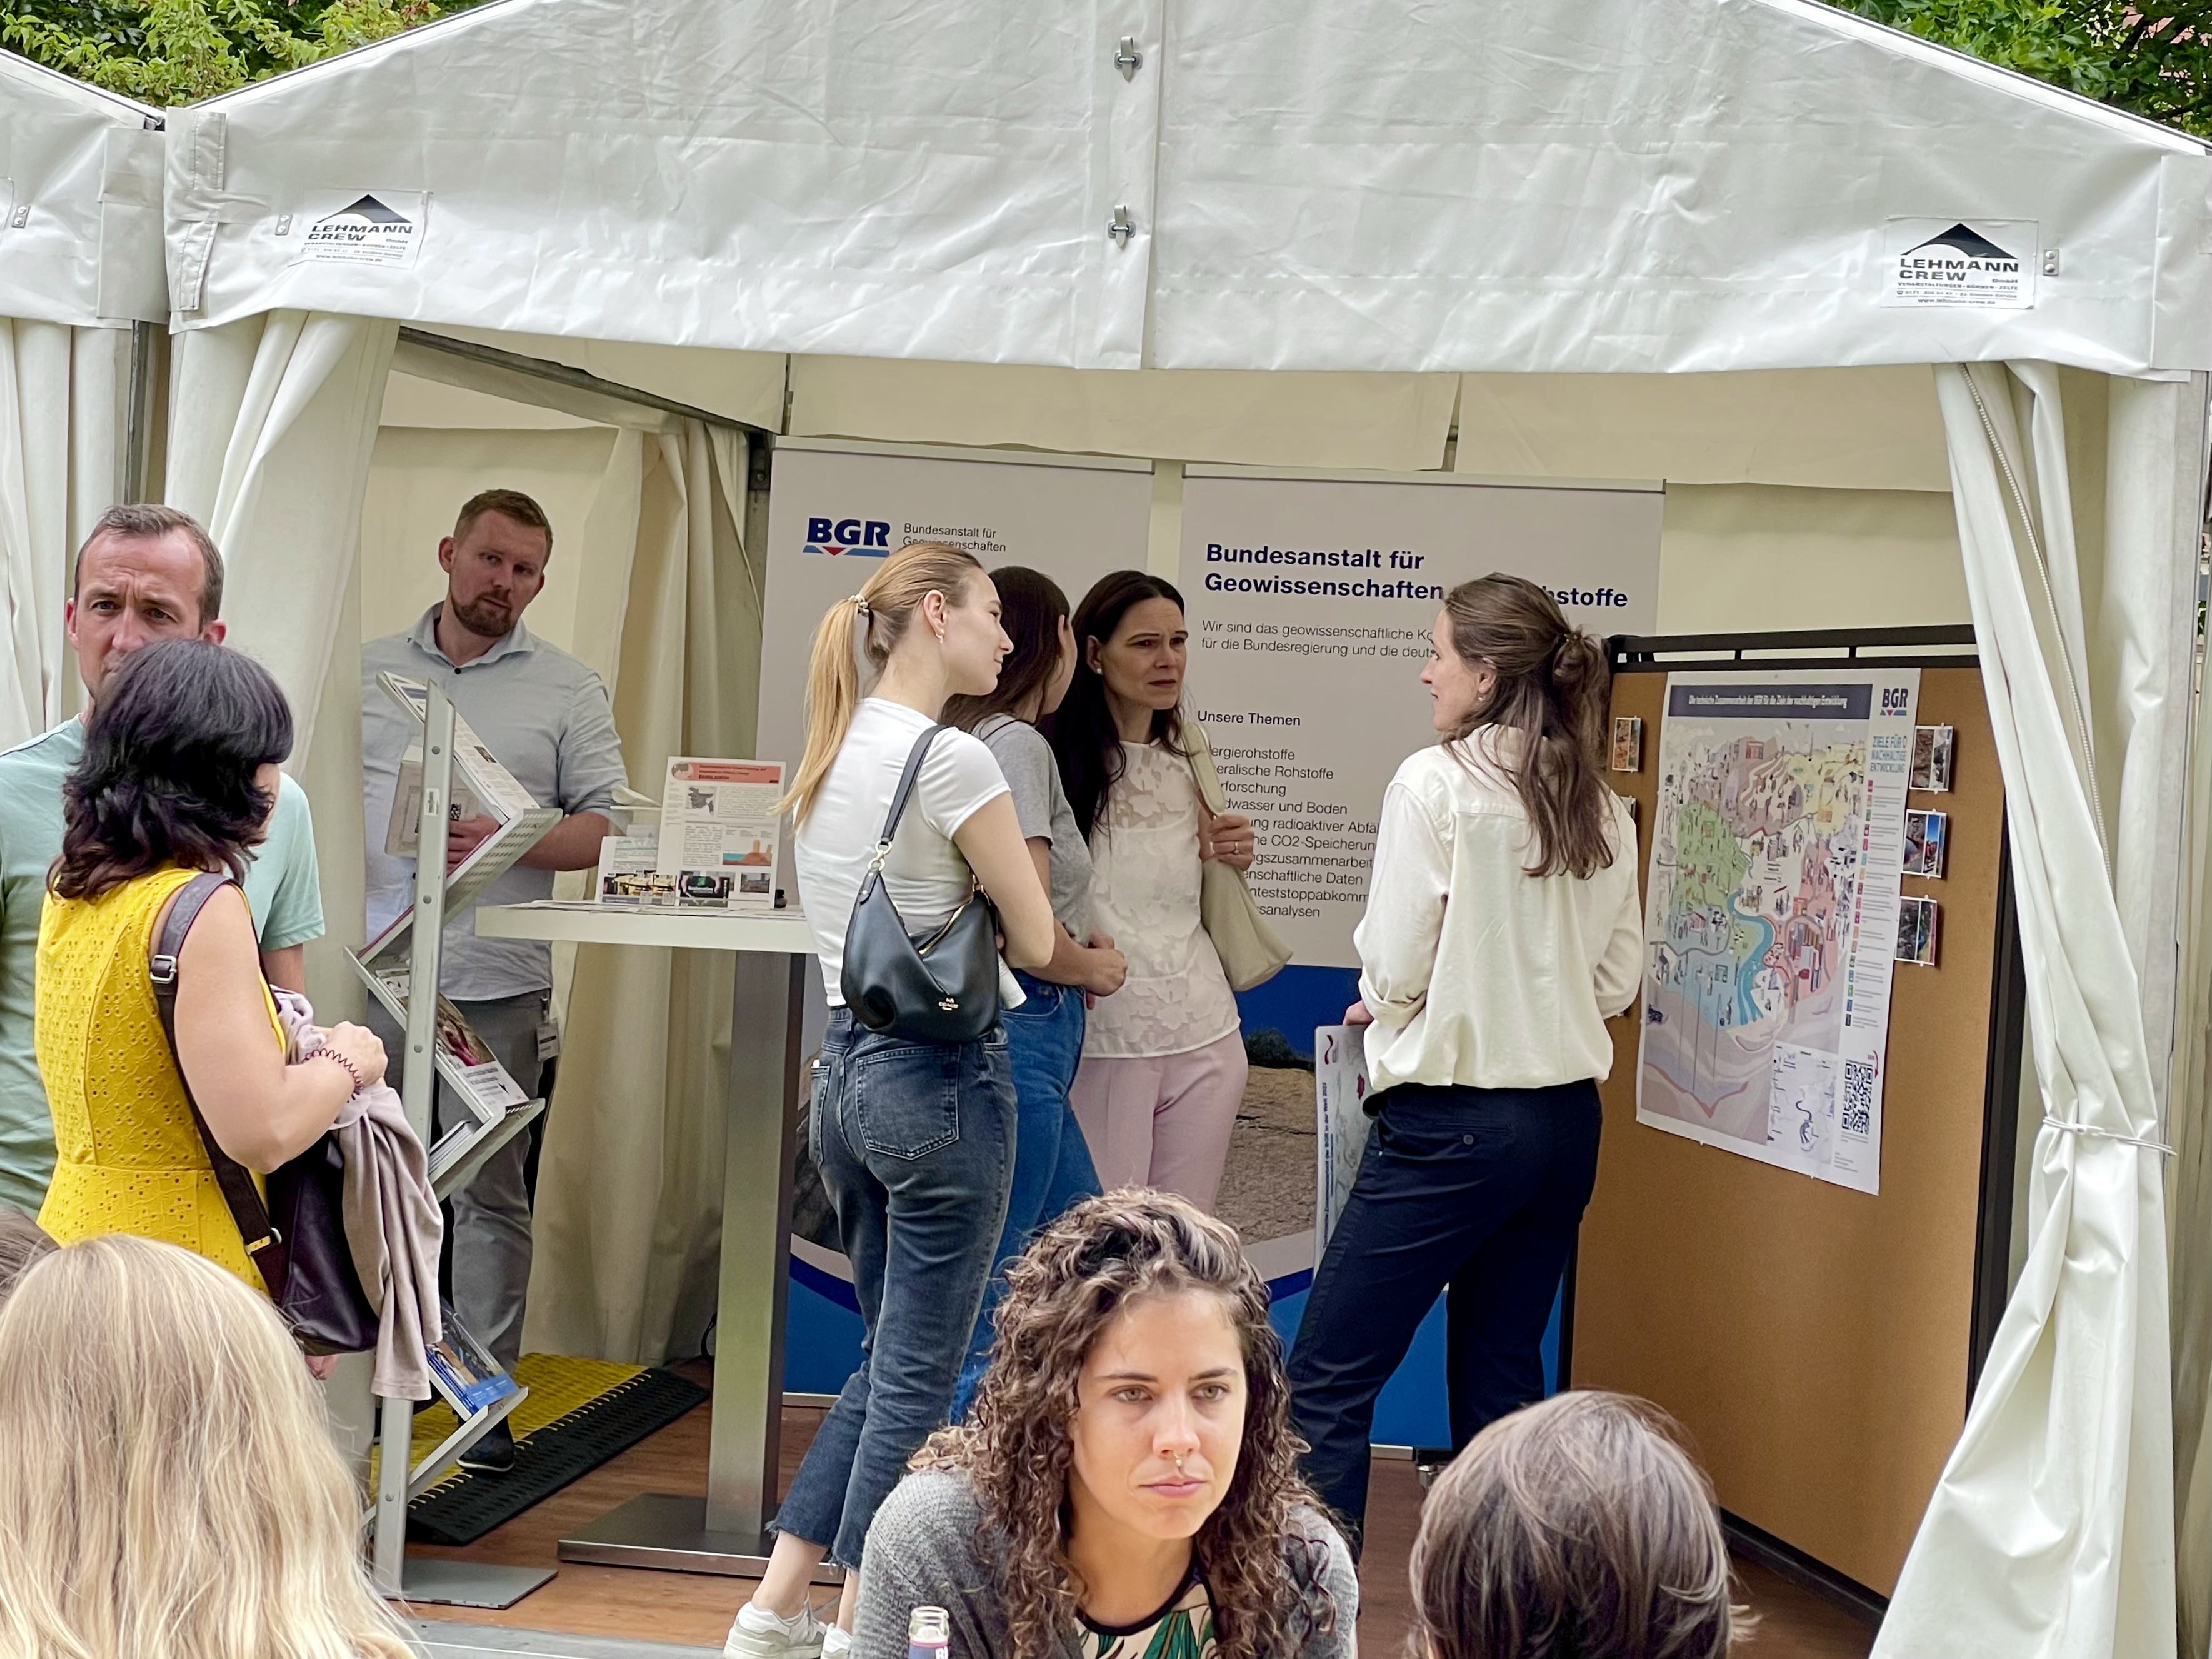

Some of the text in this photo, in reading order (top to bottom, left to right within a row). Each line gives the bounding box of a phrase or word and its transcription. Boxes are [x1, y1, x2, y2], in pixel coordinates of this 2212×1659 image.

[311, 225, 413, 234] LEHMANN
[1900, 259, 2019, 272] LEHMANN
[1899, 269, 1967, 281] CREW
[807, 518, 891, 547] BGR
[904, 523, 996, 538] Bundesanstalt für
[903, 536, 1006, 552] Geoenschaften
[1206, 544, 1424, 569] Bundesanstalt für
[1205, 573, 1444, 600] Geowissenschaften
[1202, 620, 1223, 633] Wir
[1226, 622, 1252, 633] sind
[1256, 623, 1278, 634] das
[1282, 624, 1413, 641] geowissenschaftliche
[1201, 637, 1430, 658] für die Bundesregierung und die deut
[1881, 688, 1908, 708] BGR
[1197, 710, 1301, 726] Unsere Themen
[1212, 746, 1295, 761] ergierohstoffe
[1216, 764, 1334, 779] eralische Rohstoffe
[1221, 780, 1286, 797] rforschung
[1225, 798, 1348, 814] dwasser und Boden
[1273, 819, 1344, 832] radioaktiver
[1348, 821, 1379, 834] Abfäl
[1271, 835, 1375, 851] CO2-Speicherun
[1253, 853, 1373, 868] gszusammenarbeit
[1245, 869, 1363, 885] enschaftliche Daten
[1259, 905, 1320, 918] sanalysen
